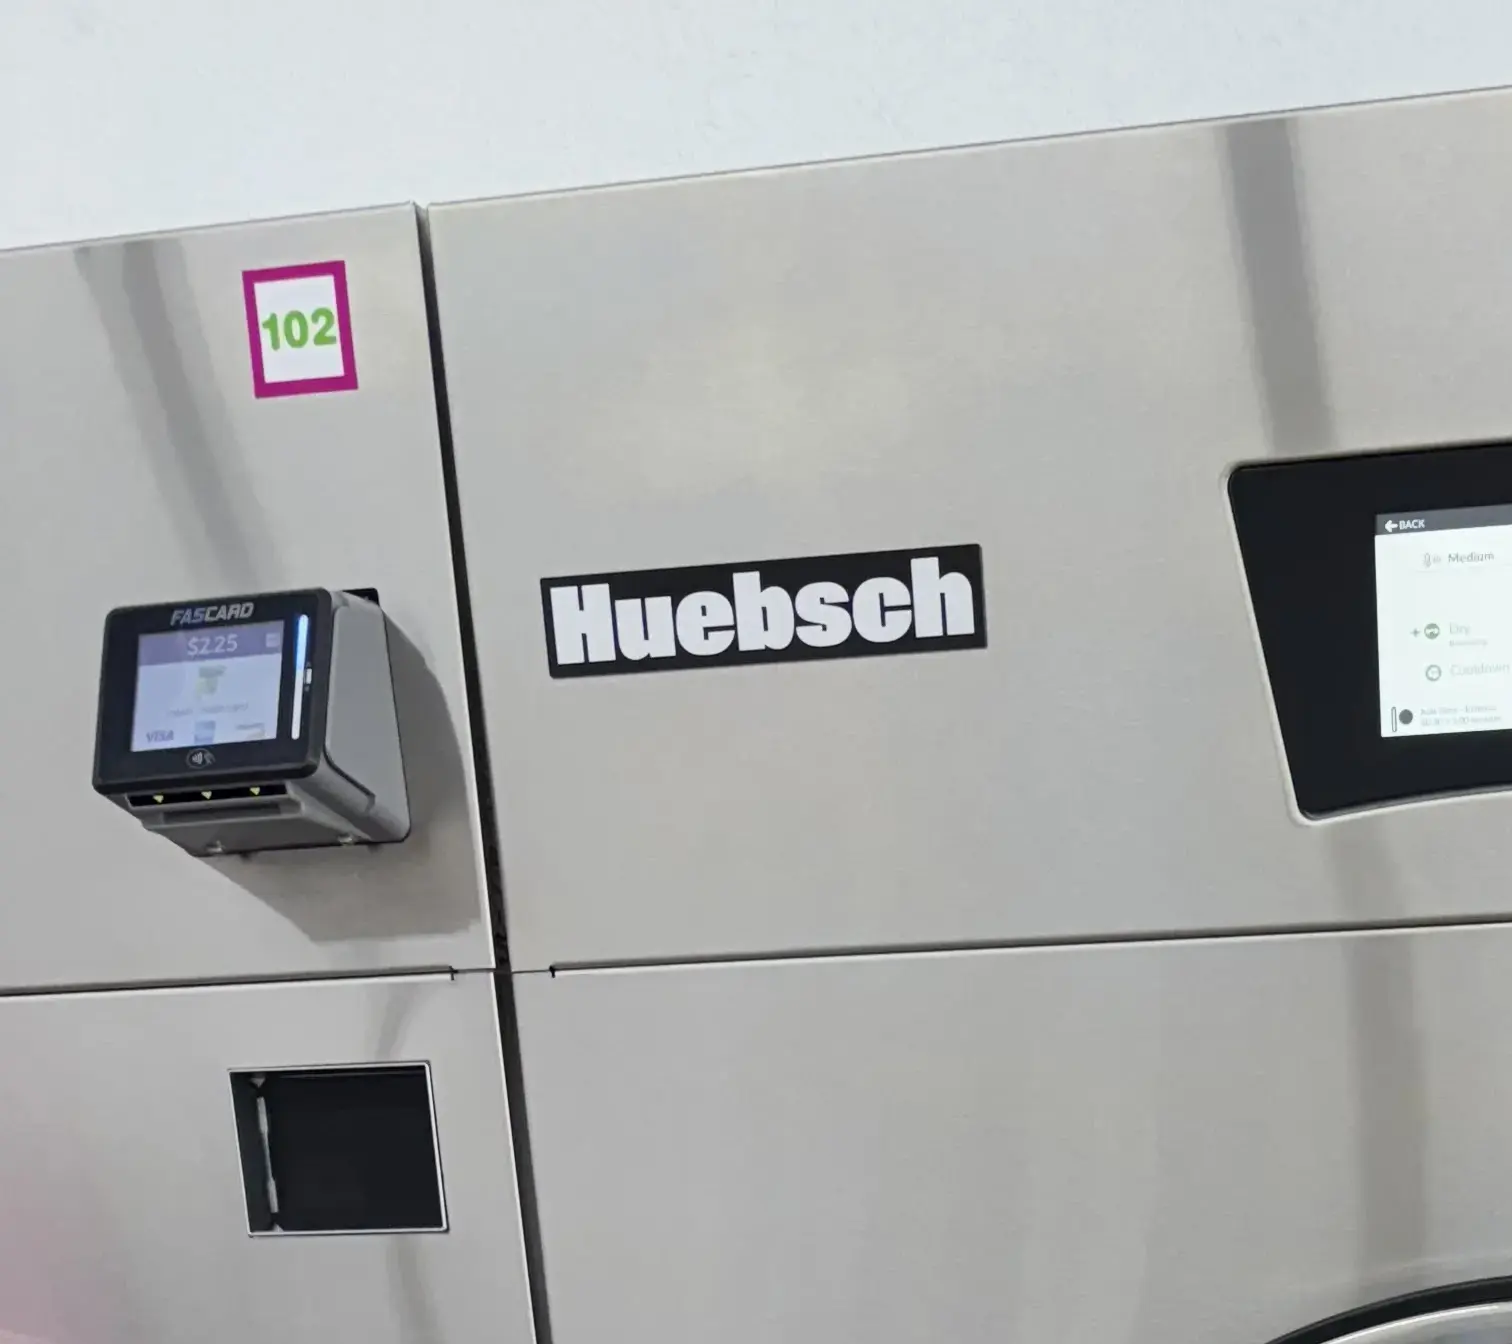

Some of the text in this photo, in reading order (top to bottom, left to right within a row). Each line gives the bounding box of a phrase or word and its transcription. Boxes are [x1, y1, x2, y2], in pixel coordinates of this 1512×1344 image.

[261, 307, 337, 351] 102
[1399, 518, 1426, 531] BACK
[1447, 551, 1495, 564] Medium
[170, 602, 254, 626] FASCARD
[549, 556, 975, 666] Huebsch
[187, 633, 238, 656] $2.25
[146, 729, 174, 744] VISA
